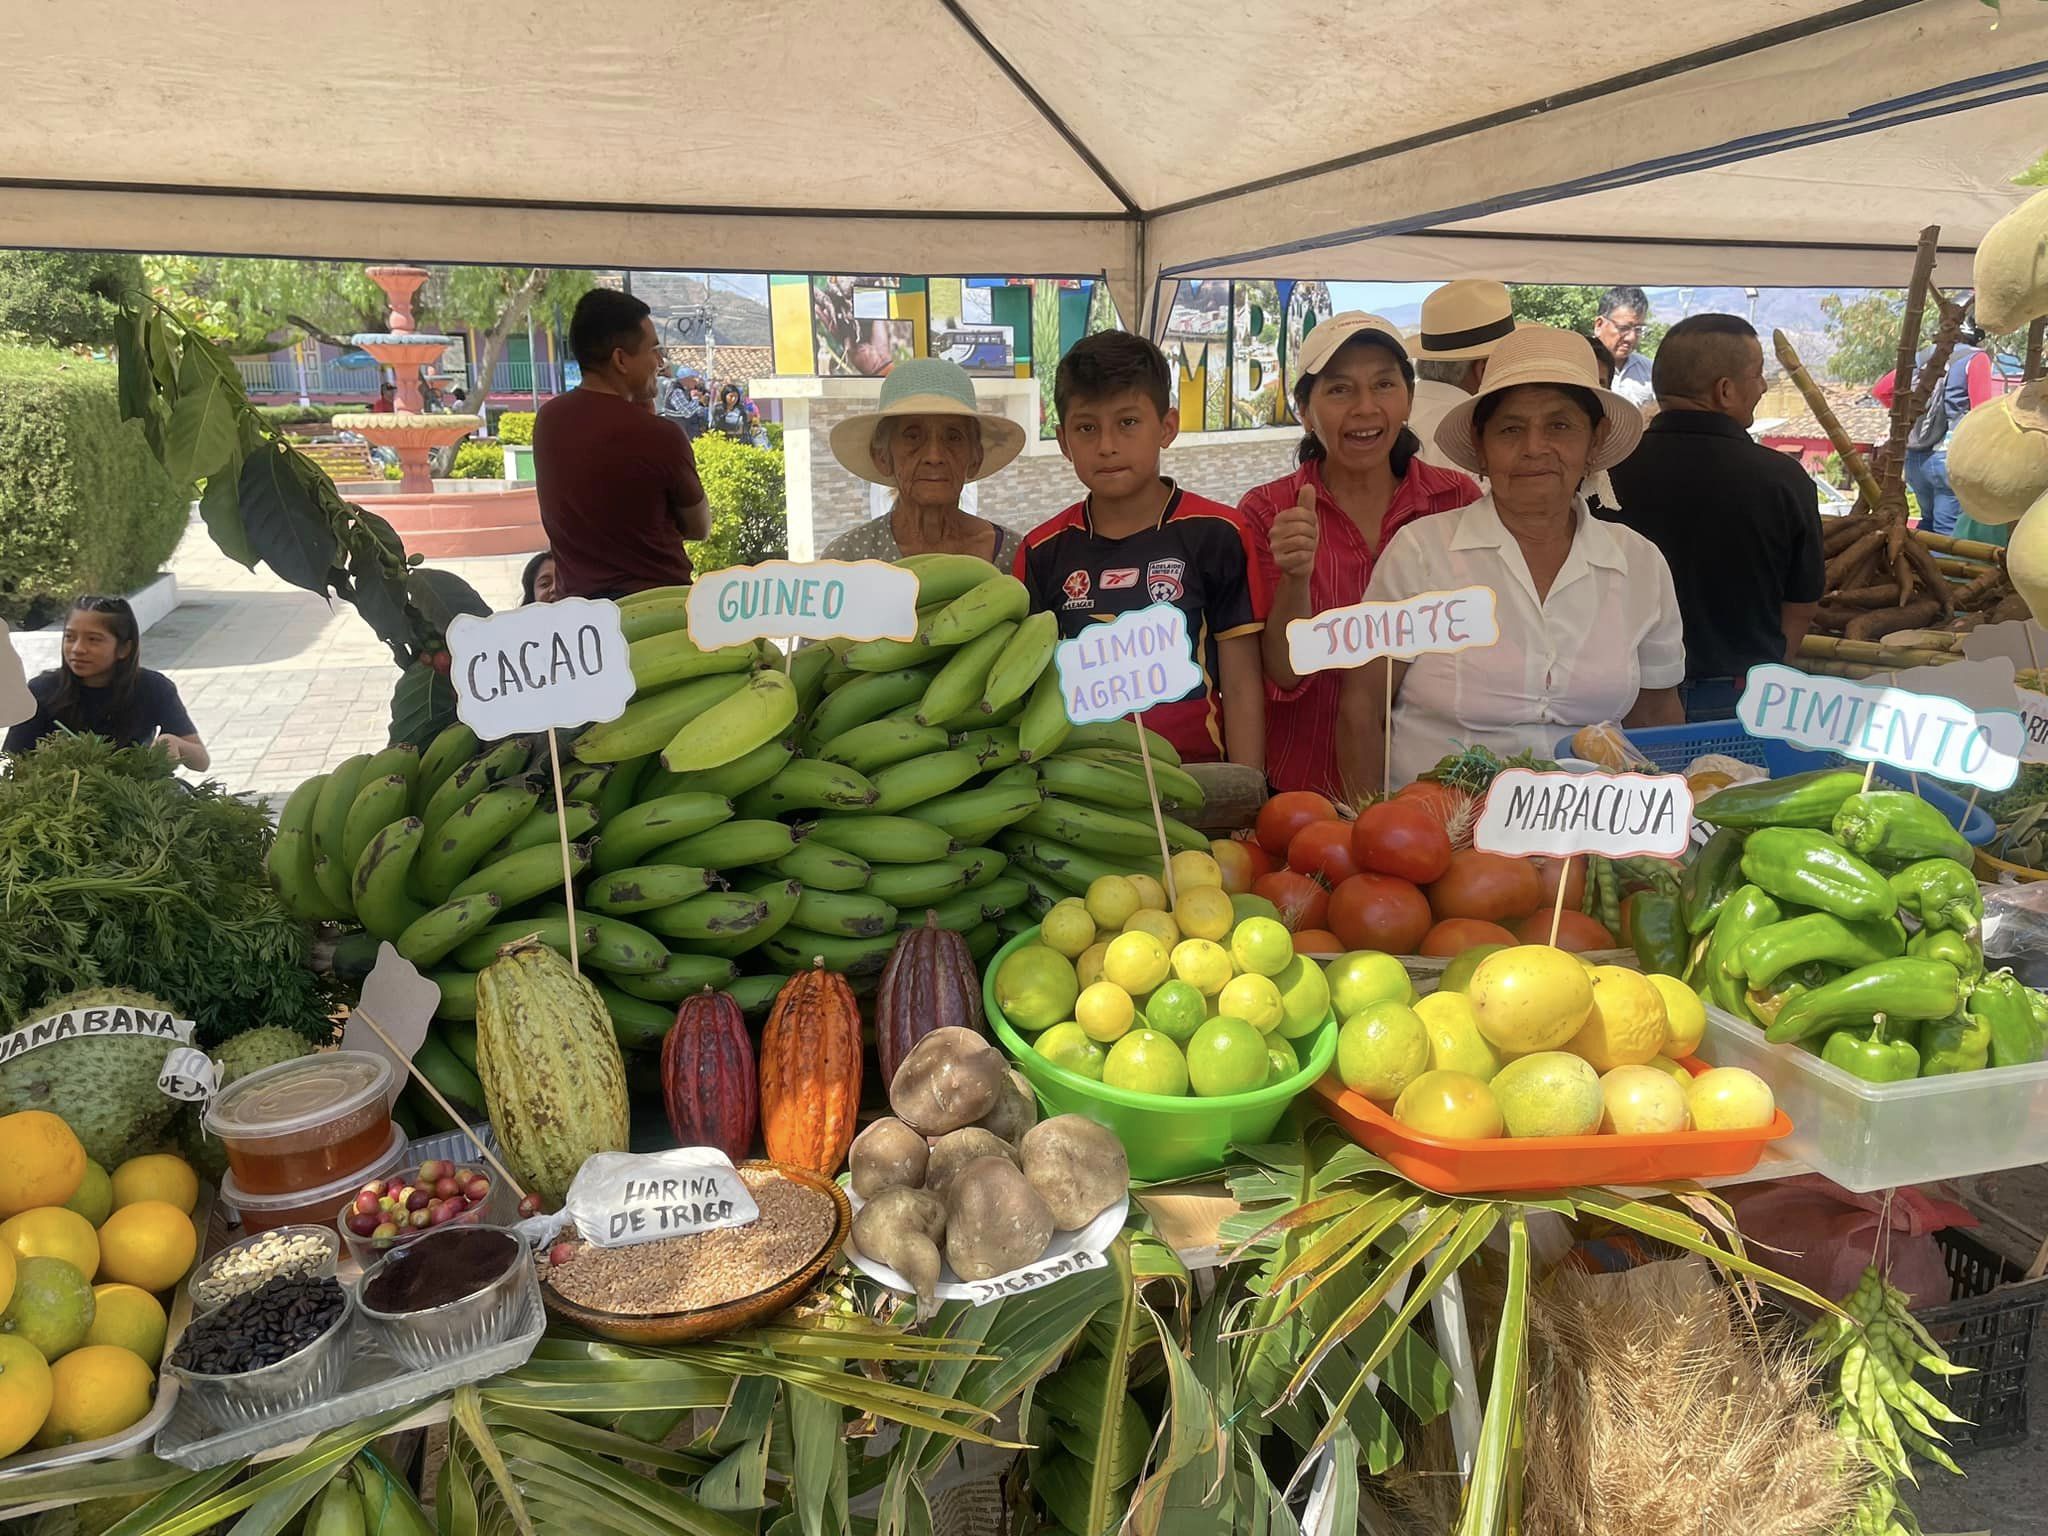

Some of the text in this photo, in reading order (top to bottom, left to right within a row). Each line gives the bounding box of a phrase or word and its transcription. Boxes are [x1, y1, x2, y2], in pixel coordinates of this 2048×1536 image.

[718, 578, 844, 623] GUINEO
[1078, 617, 1178, 671] LIMON
[1312, 599, 1471, 655] TOMATE
[467, 624, 603, 703] CACAO
[1072, 662, 1168, 714] AGRIO
[1754, 682, 1993, 774] PIMIENTO
[1504, 783, 1676, 835] MARACUYA
[624, 1176, 719, 1205] HARINA
[609, 1200, 734, 1239] DE TRIGO
[972, 1251, 1094, 1301] JICAMA
